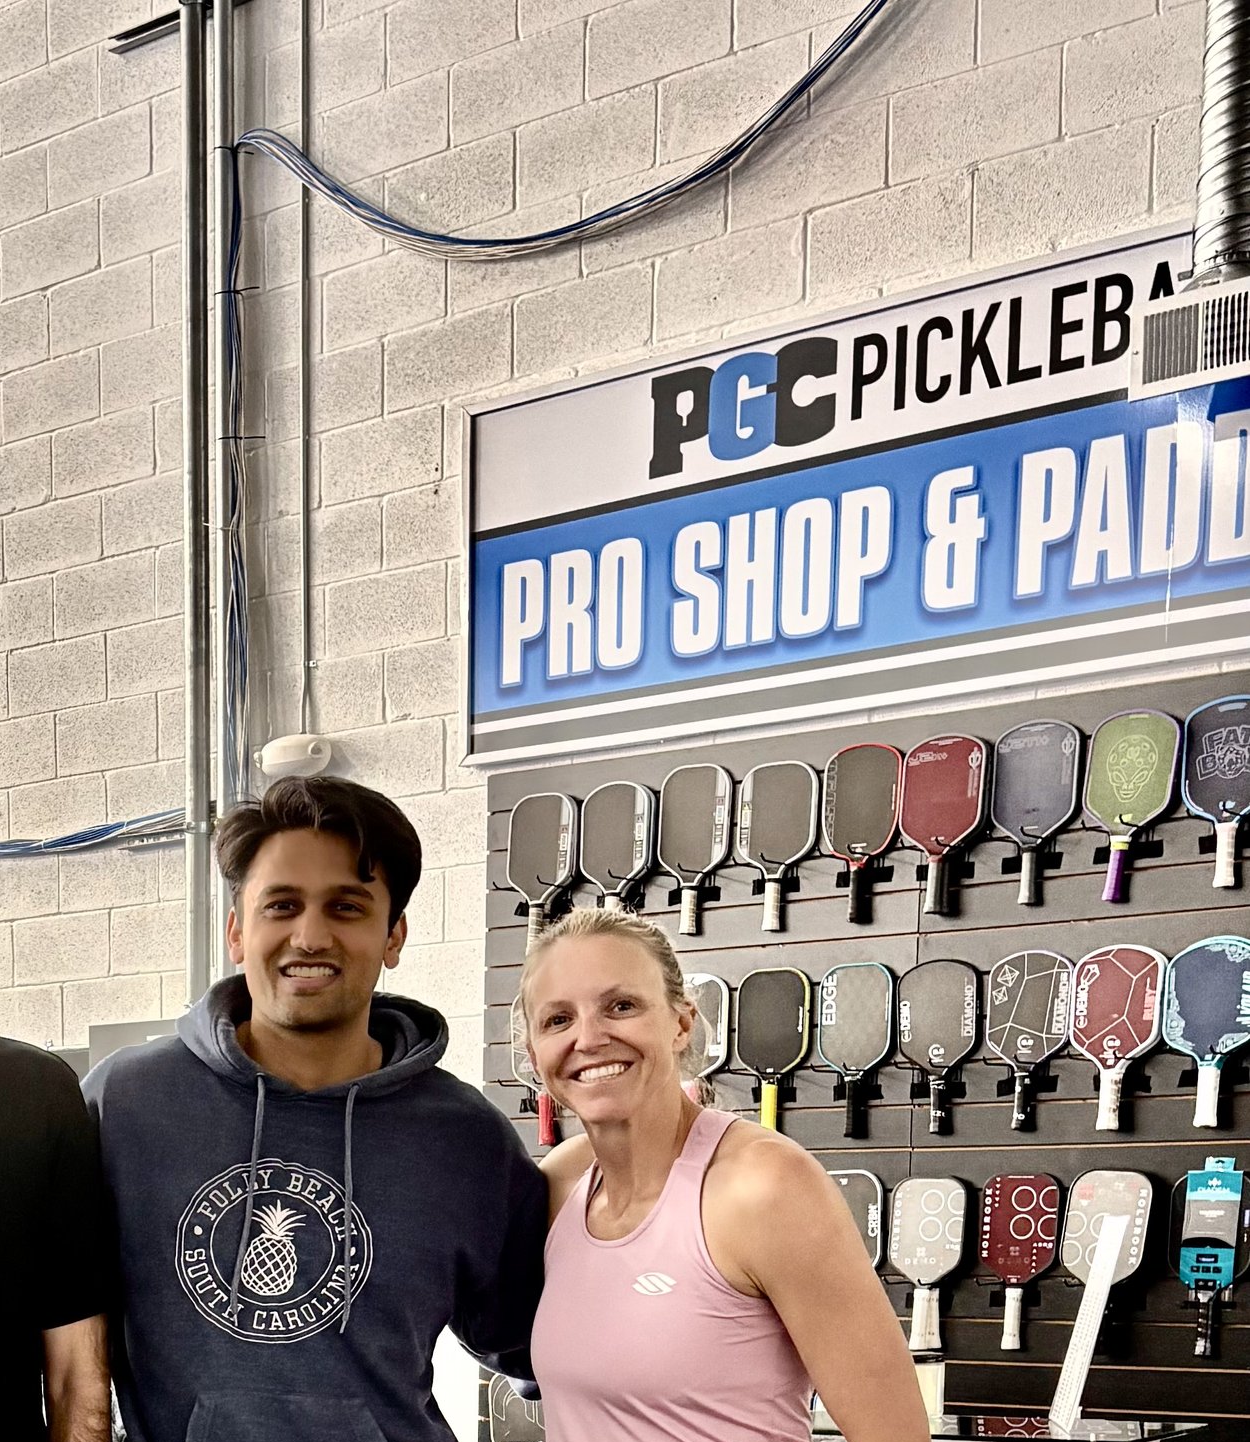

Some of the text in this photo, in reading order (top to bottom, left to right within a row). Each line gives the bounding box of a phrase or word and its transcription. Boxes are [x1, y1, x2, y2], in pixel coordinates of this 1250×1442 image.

[647, 336, 840, 480] PGC
[501, 536, 643, 687] PRO
[671, 485, 892, 658] SHOP
[921, 465, 986, 613] &
[822, 973, 838, 1026] EDGE
[899, 1000, 911, 1031] DEMO
[963, 985, 975, 1037] DIAMOND
[1053, 980, 1069, 1035] DIAMOND
[197, 1170, 273, 1221] FOLLY
[286, 1173, 358, 1241] BEACH
[867, 1203, 879, 1238] CRBN
[890, 1190, 903, 1260] HOLBROOK
[981, 1187, 993, 1258] HOLBROOK
[1127, 1188, 1148, 1265] HOLBROOK
[184, 1248, 244, 1321] SOUTH
[252, 1263, 360, 1330] CAROLINA
